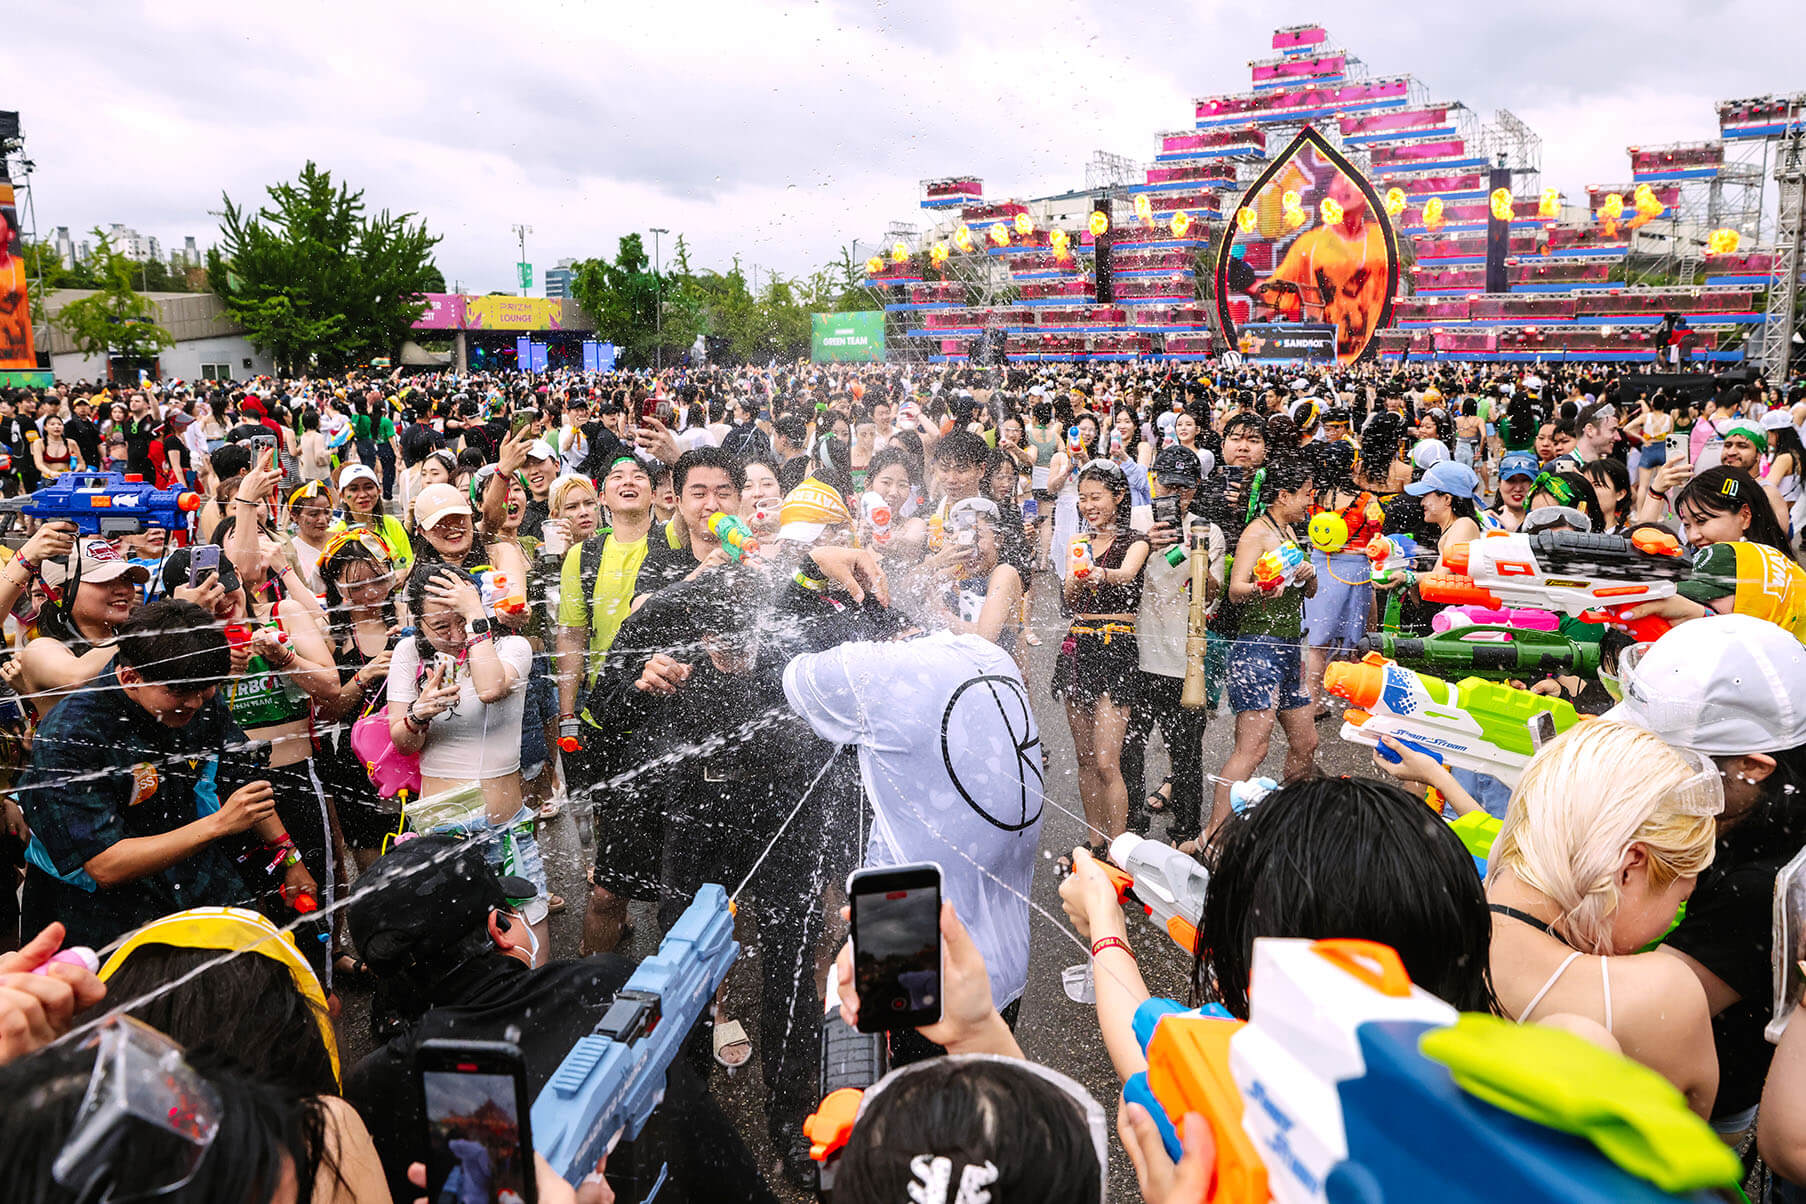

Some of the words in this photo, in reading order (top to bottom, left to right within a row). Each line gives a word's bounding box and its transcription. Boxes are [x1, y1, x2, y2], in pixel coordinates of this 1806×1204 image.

[500, 314, 532, 323] LOUNGE
[823, 337, 846, 346] GREEN
[847, 336, 868, 345] TEAM
[1283, 339, 1324, 348] SANDBOX
